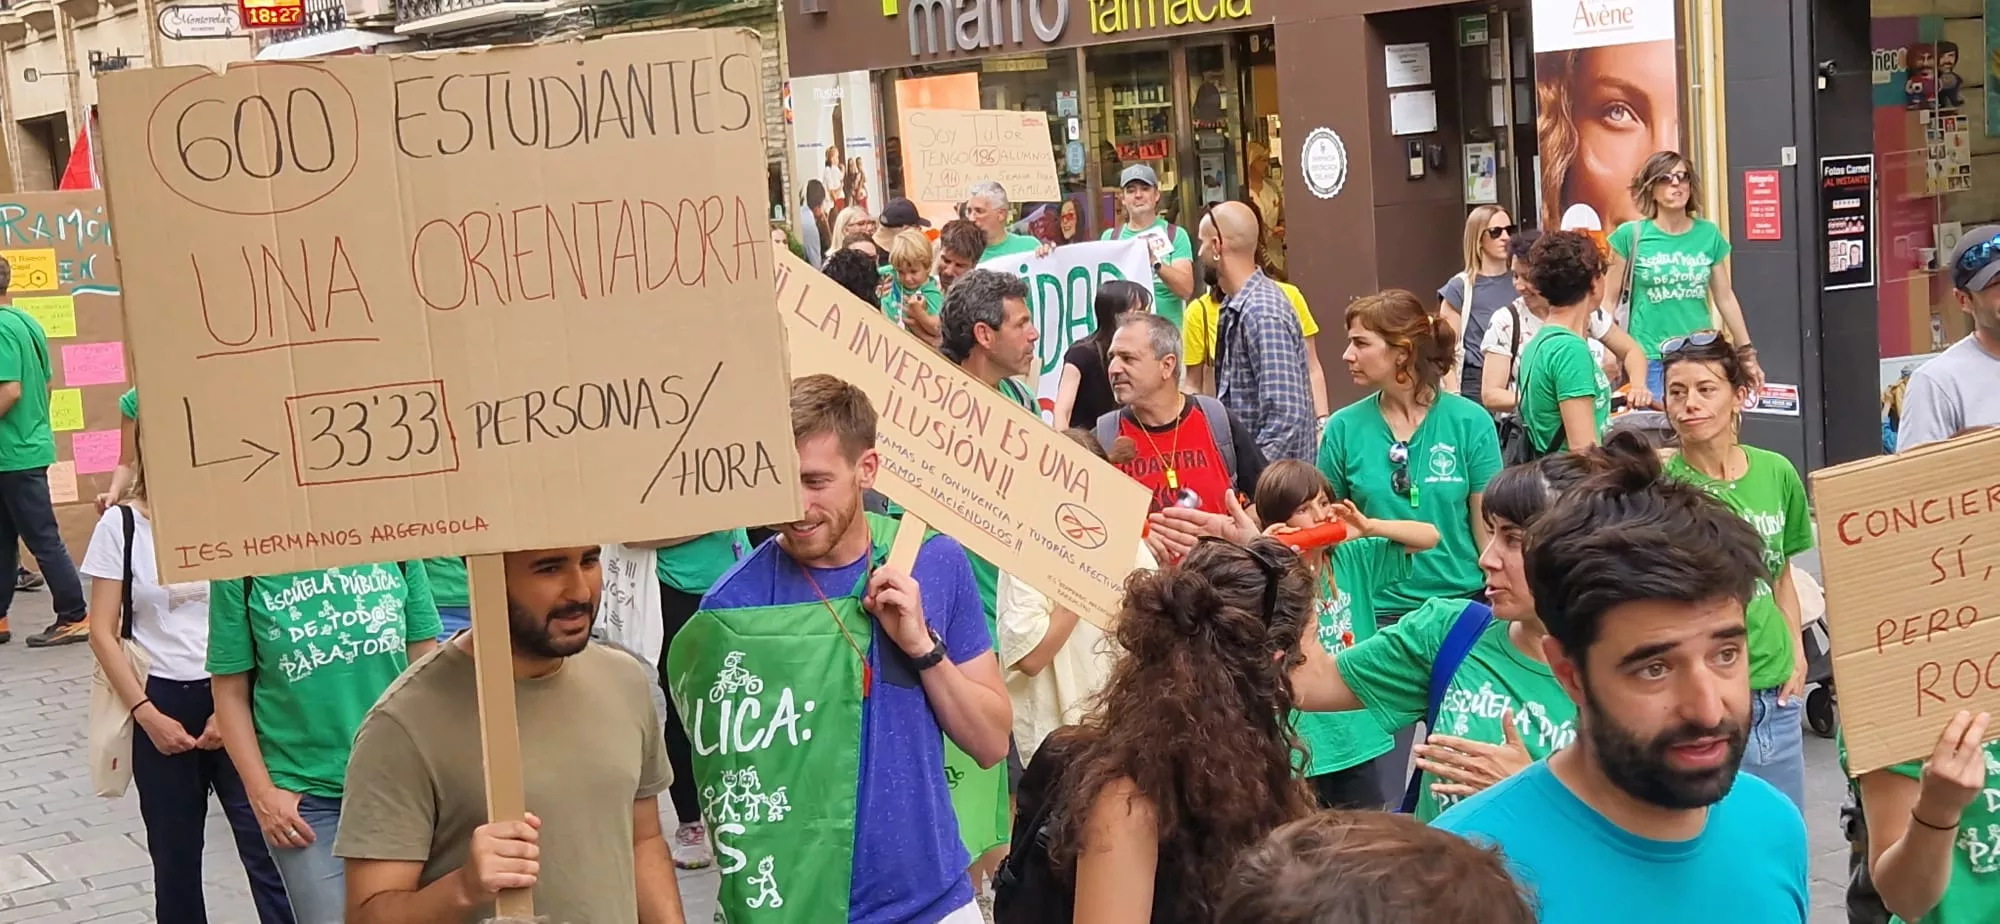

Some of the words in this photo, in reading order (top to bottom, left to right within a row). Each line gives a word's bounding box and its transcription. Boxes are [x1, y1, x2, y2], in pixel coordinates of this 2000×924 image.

[250, 8, 300, 23] 18:27
[1573, 0, 1634, 29] Avène
[176, 87, 335, 182] 600
[920, 149, 968, 169] TENGO
[191, 236, 374, 346] UNA
[412, 195, 765, 311] ORIENTADORA
[794, 284, 841, 340] LA
[1000, 418, 1030, 461] ES
[1039, 443, 1090, 503] UNA
[672, 440, 781, 496] HORA
[921, 459, 937, 475] DE
[941, 472, 1011, 525] CONVIVENCIA
[1015, 519, 1025, 531] Y
[175, 541, 233, 569] IES
[244, 528, 362, 557] HERMANOS
[370, 516, 489, 544] ARGENSOLA
[1930, 534, 1992, 584] SÍ,
[262, 573, 337, 611] ESCUELA
[288, 620, 318, 643] DE
[1876, 606, 1977, 654] PERO
[284, 644, 345, 677] PARA
